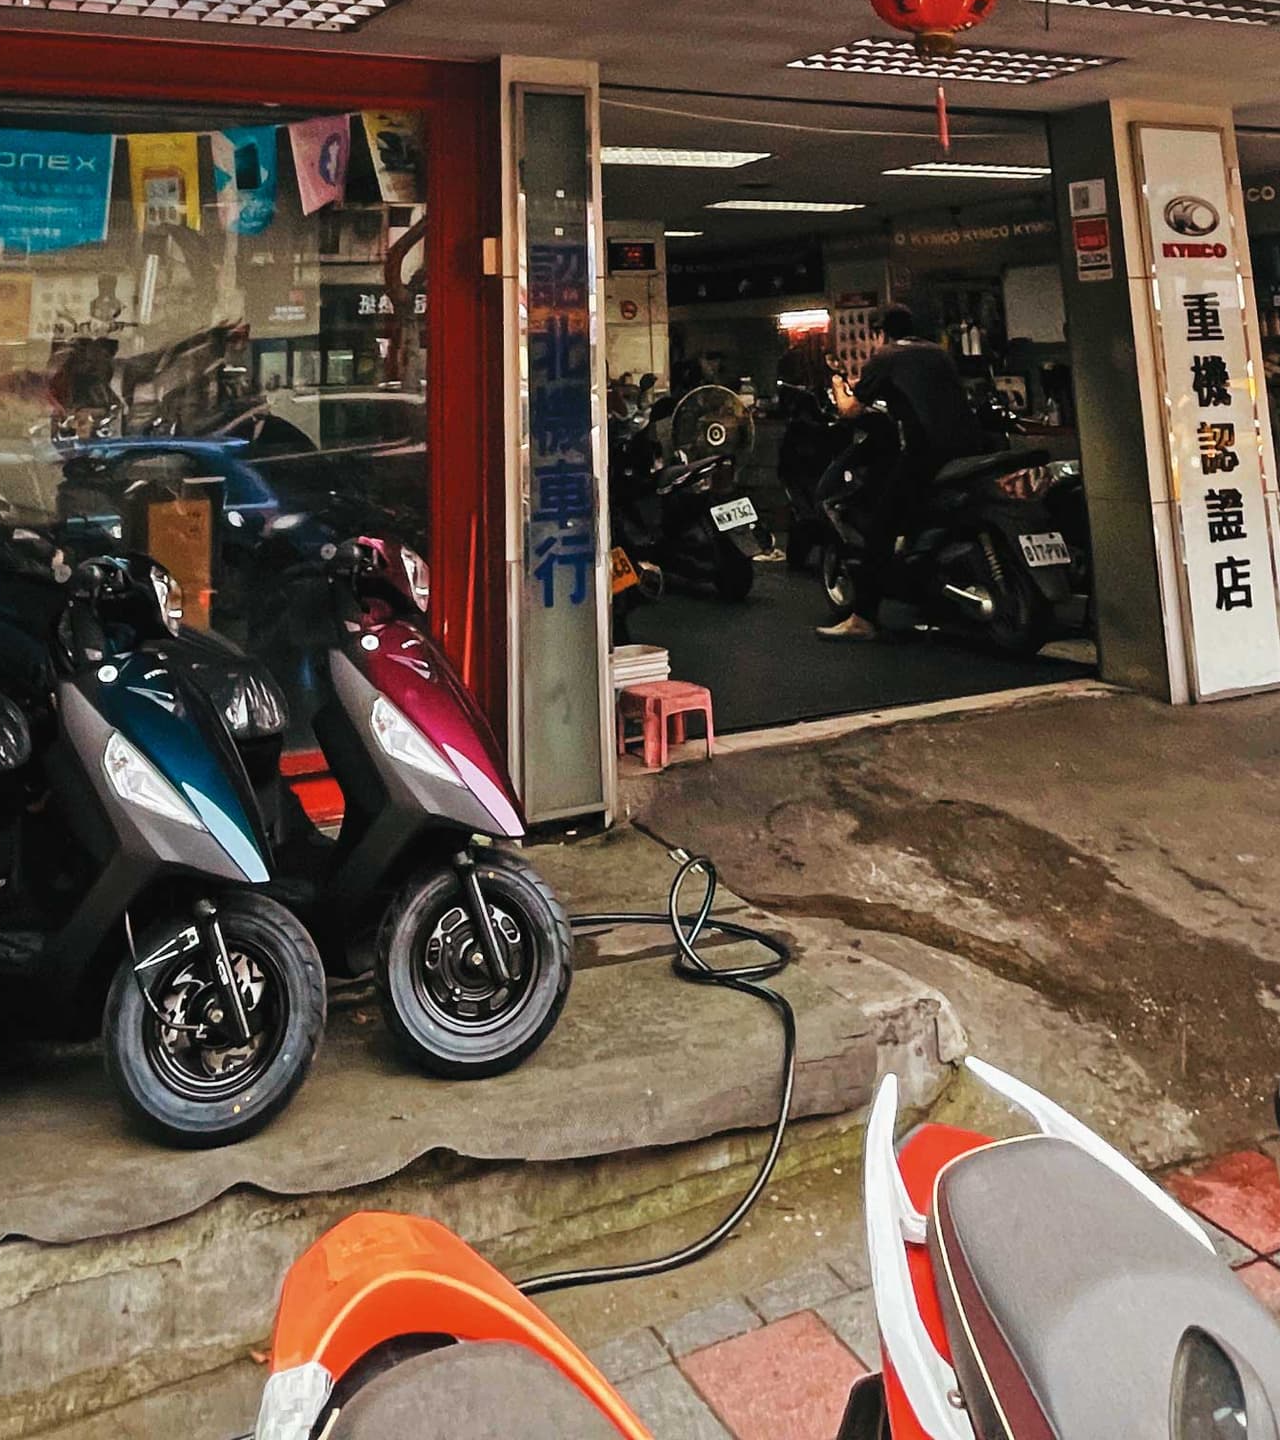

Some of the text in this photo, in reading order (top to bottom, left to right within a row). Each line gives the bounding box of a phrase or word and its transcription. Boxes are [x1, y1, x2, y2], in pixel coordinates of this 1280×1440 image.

[1162, 243, 1227, 258] KYMCO
[1182, 291, 1254, 612] 重機認證店
